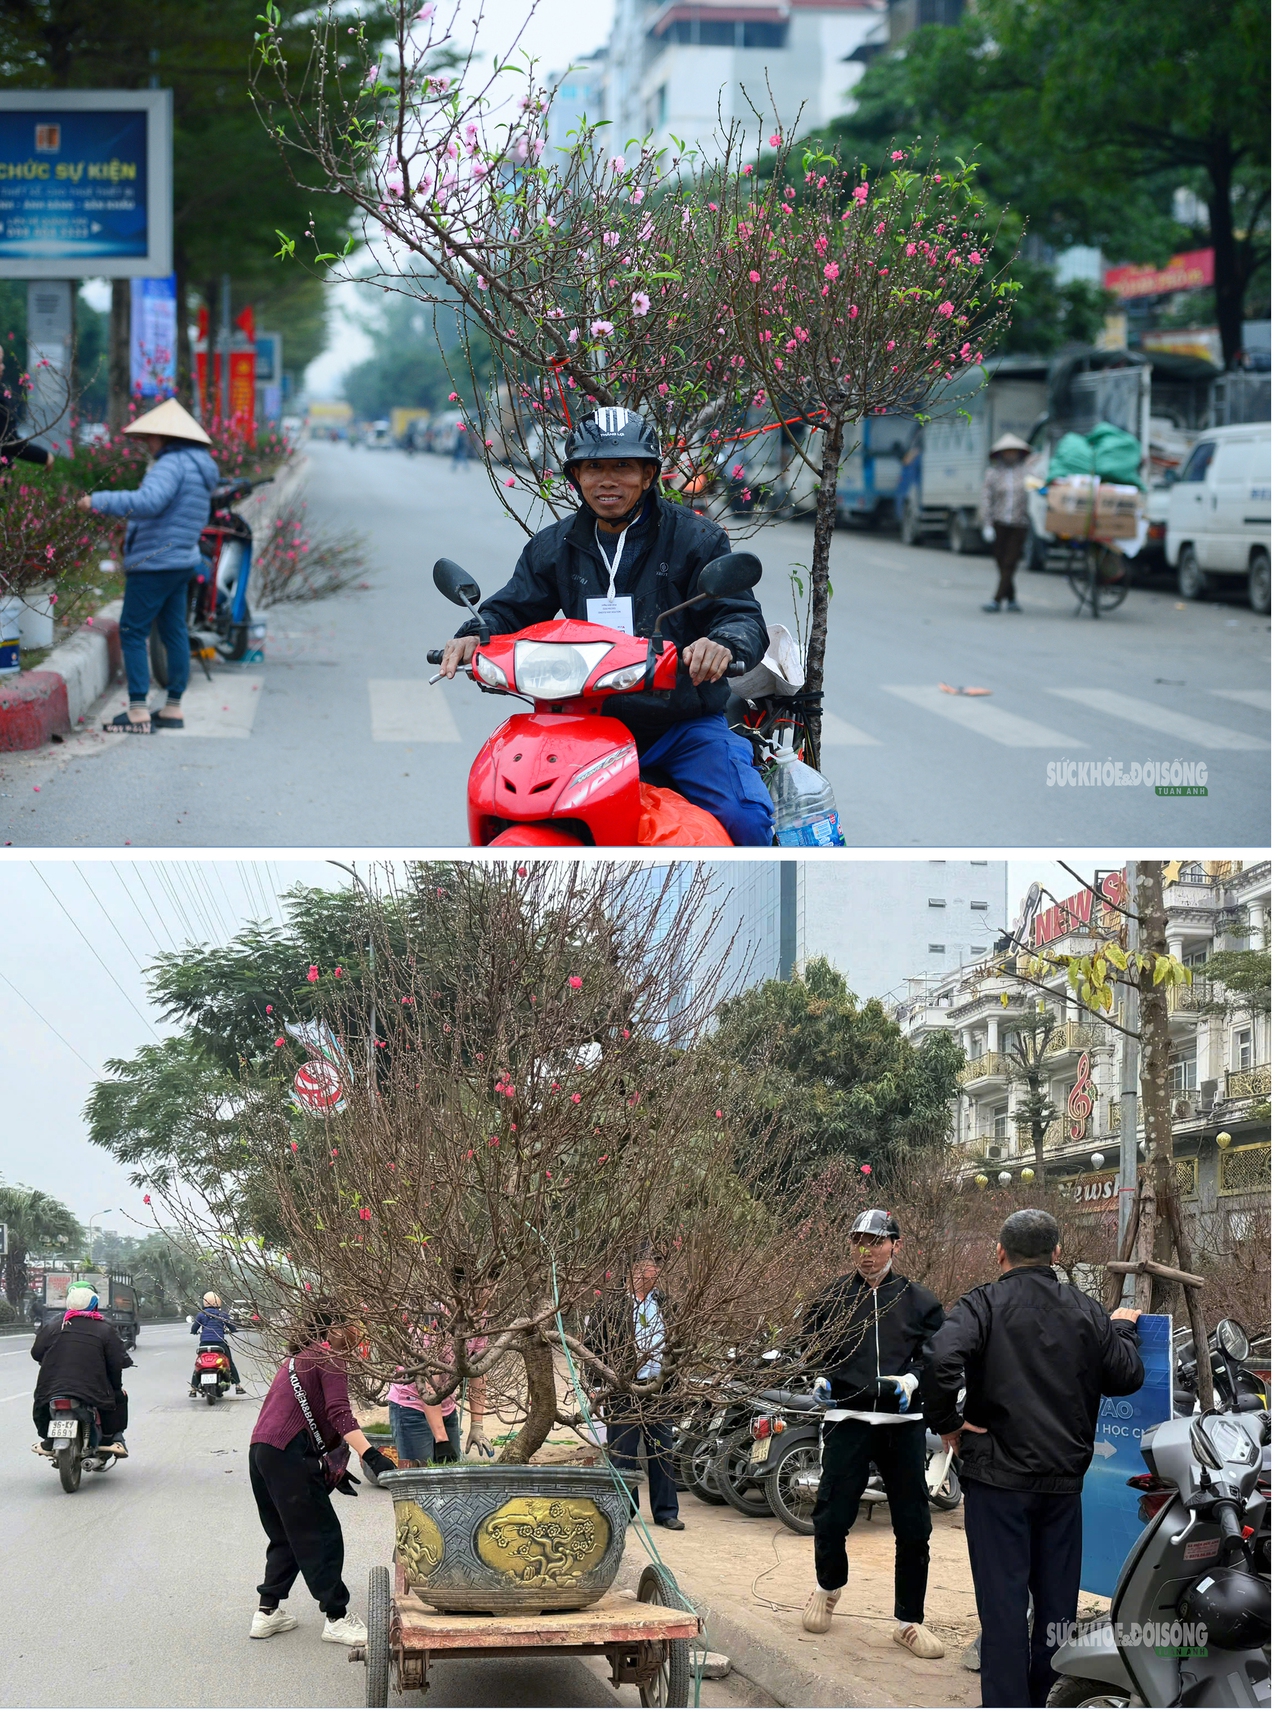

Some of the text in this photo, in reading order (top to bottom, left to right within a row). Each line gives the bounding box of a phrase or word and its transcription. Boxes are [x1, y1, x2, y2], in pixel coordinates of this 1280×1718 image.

[87, 157, 137, 184] KIỆN
[1035, 886, 1093, 947] NEW
[1103, 1424, 1129, 1437] HỌC
